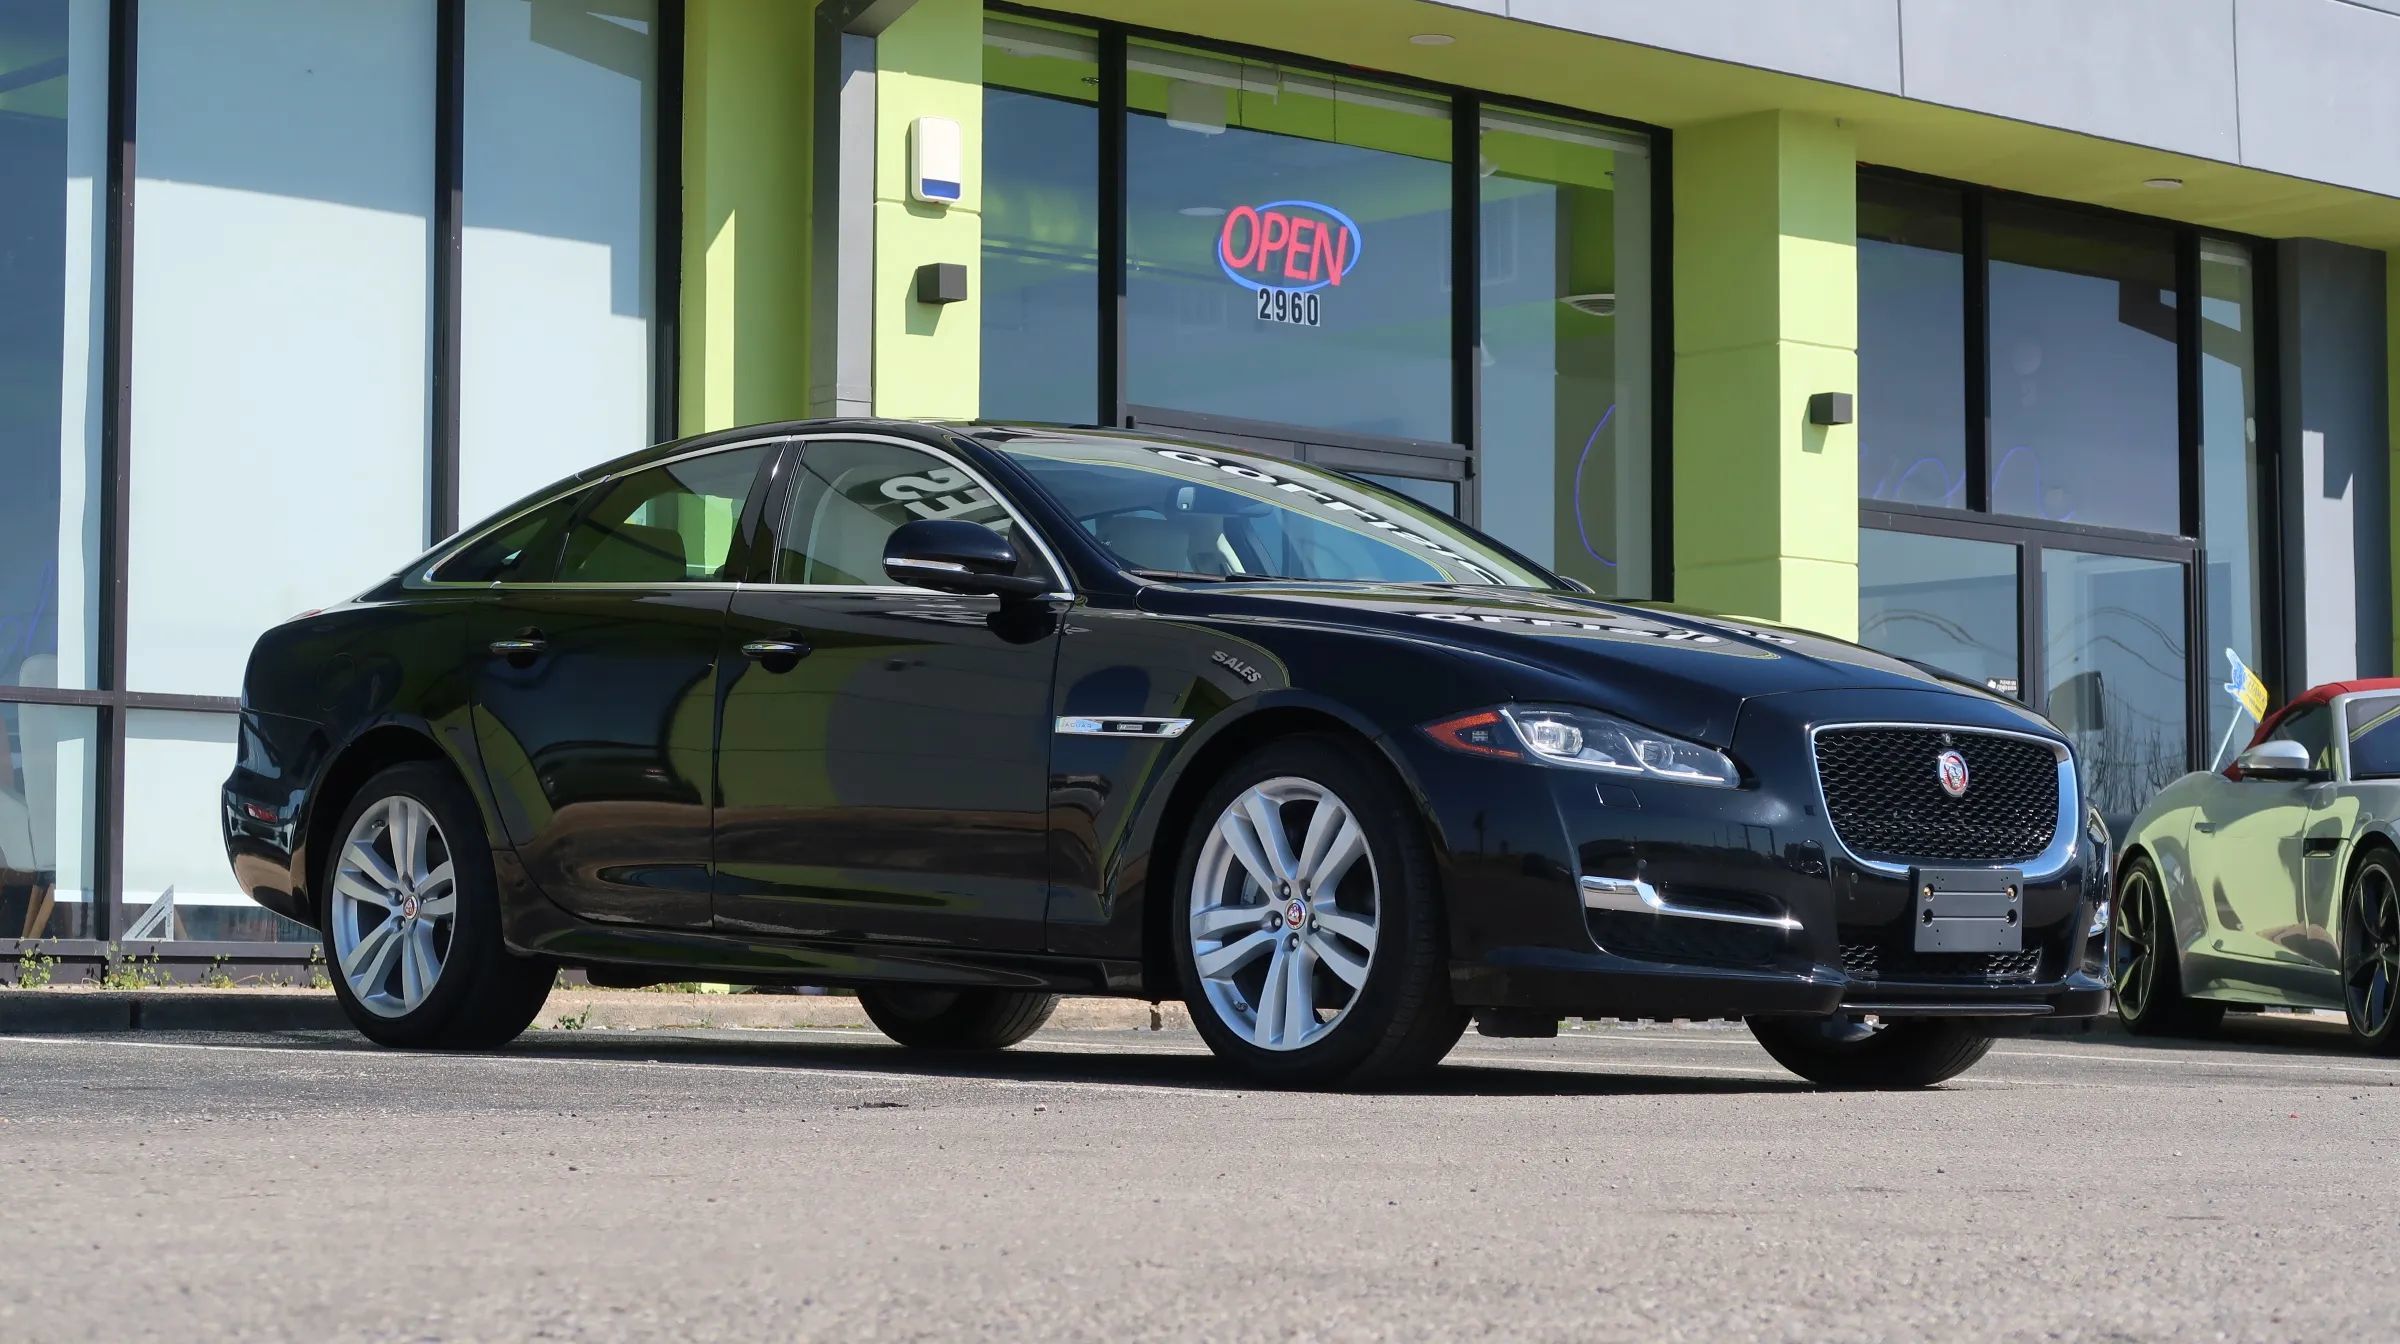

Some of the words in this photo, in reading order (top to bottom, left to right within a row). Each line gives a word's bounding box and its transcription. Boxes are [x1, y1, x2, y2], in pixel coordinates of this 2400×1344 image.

[1222, 206, 1349, 286] OPEN
[1259, 288, 1318, 326] 2960
[1211, 650, 1262, 682] SALES
